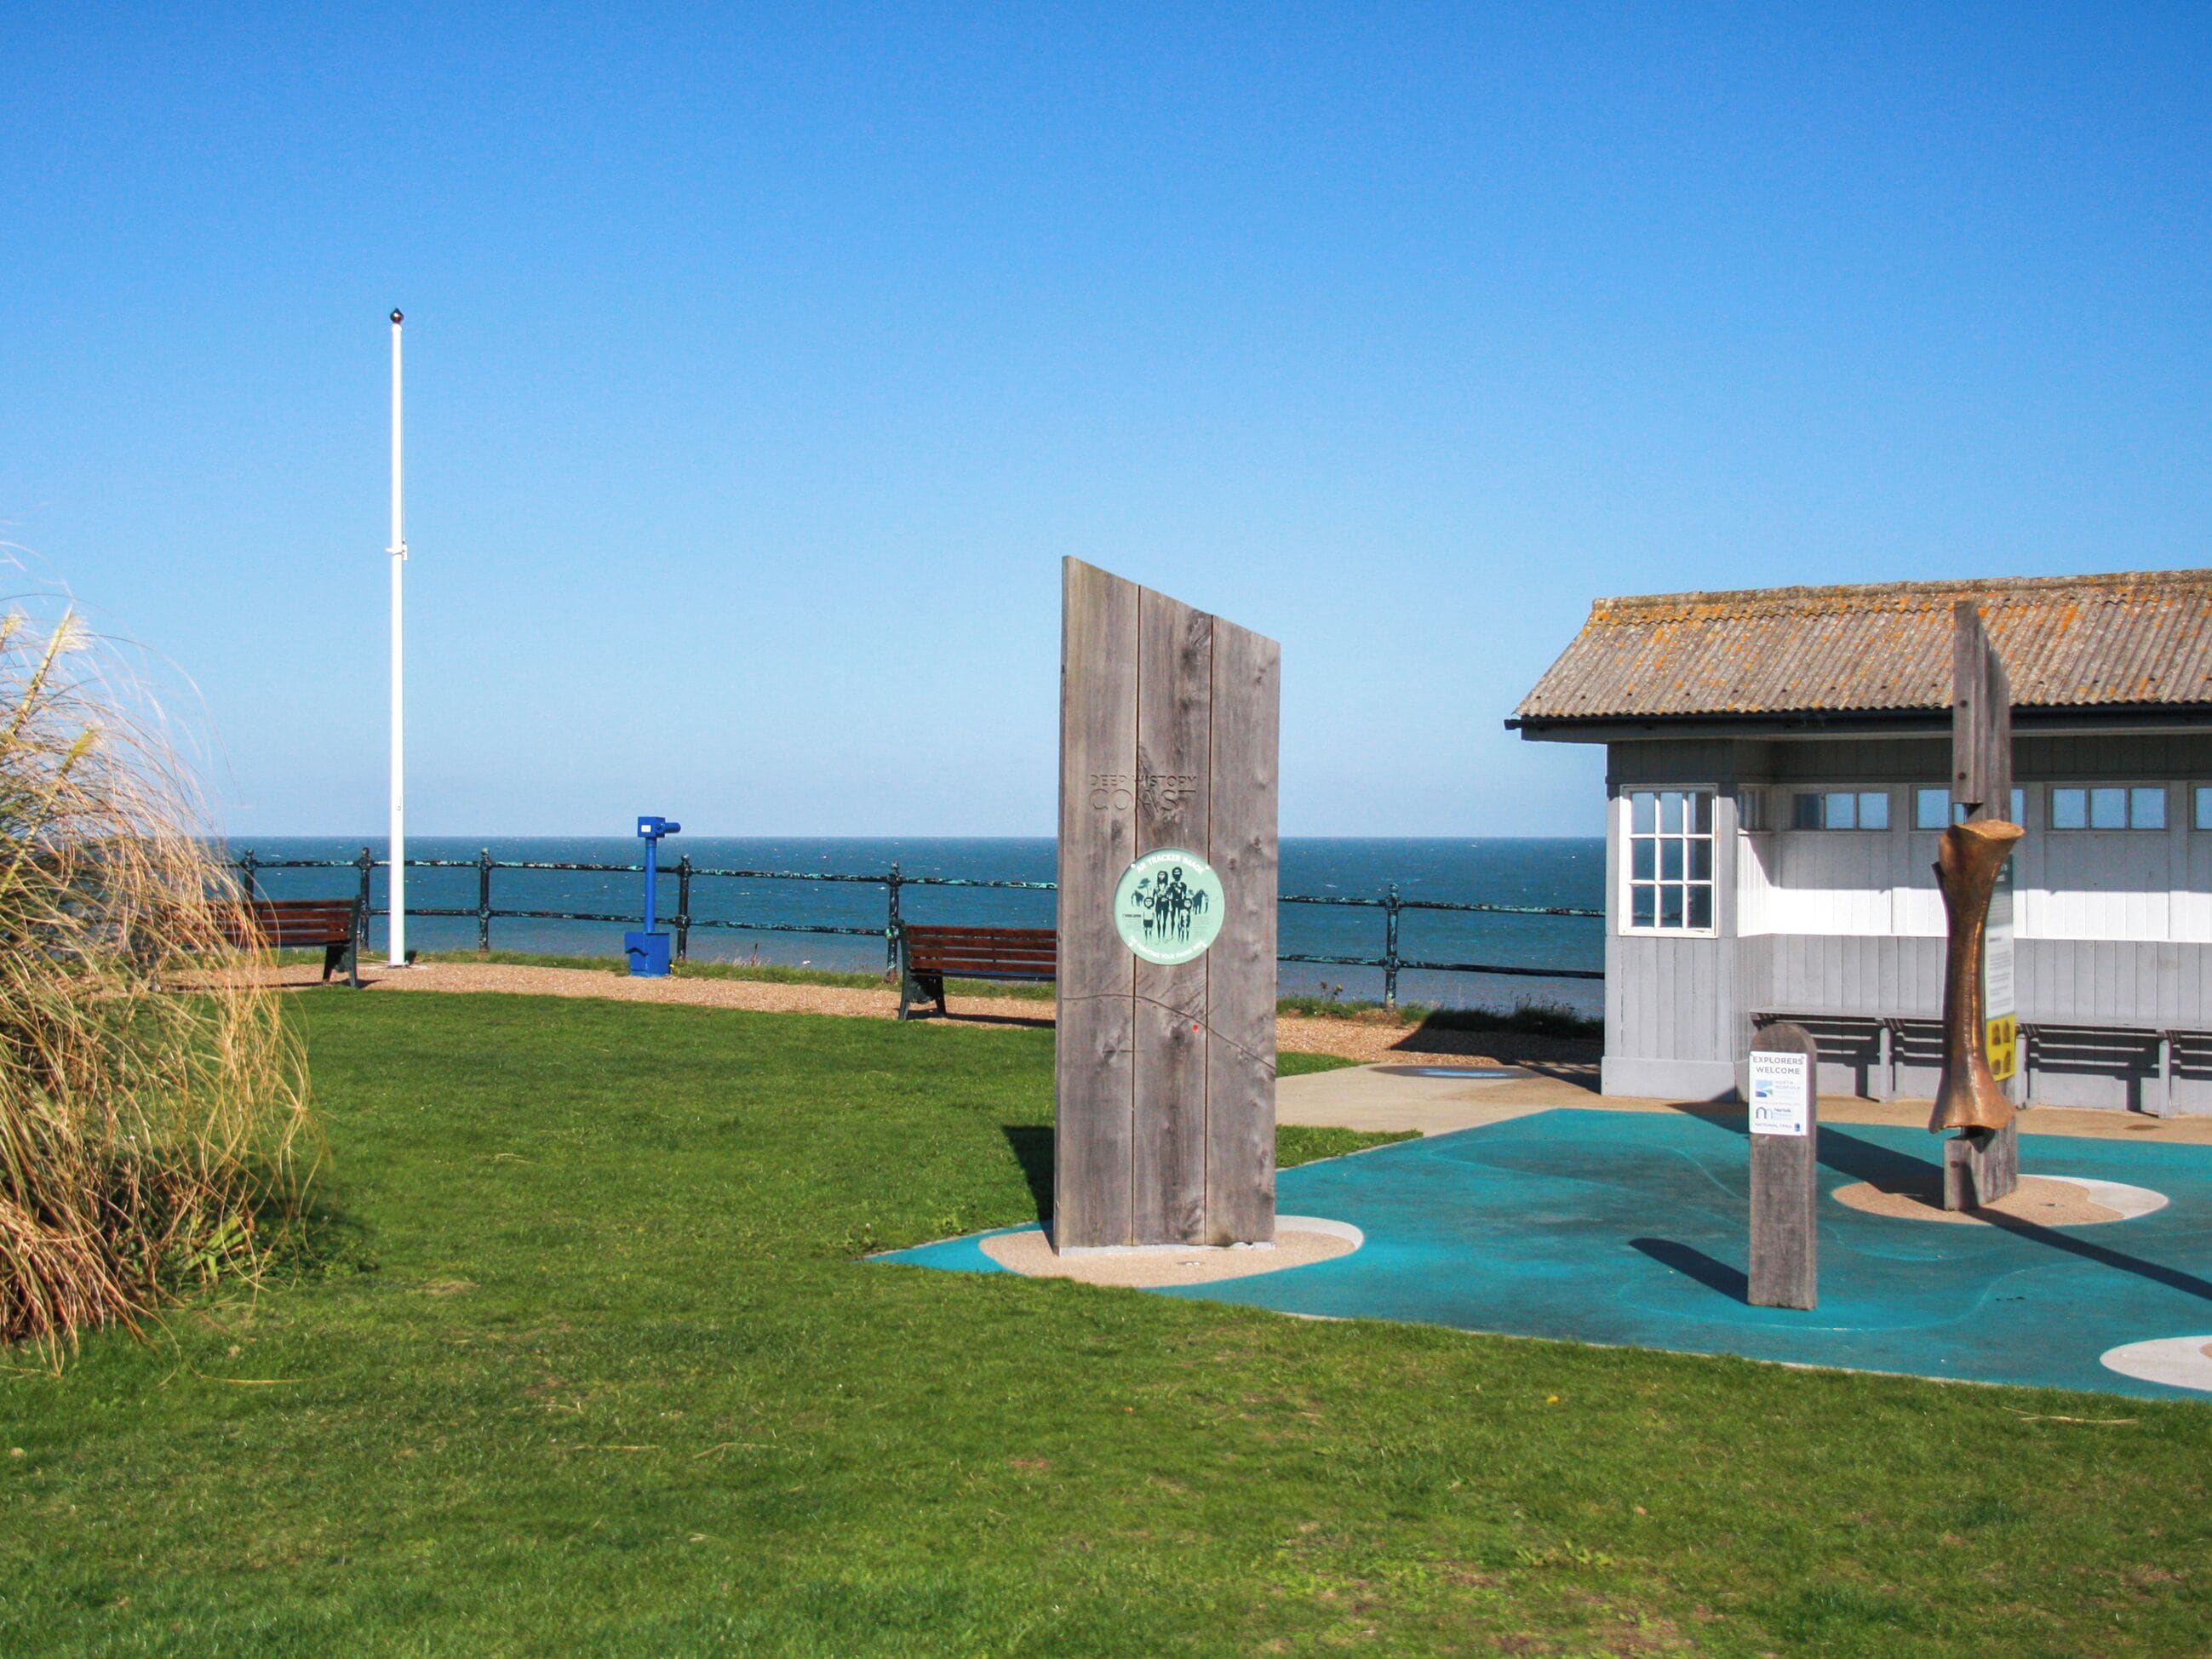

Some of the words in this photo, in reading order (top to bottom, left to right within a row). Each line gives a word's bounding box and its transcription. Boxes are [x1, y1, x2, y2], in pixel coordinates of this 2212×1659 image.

[1090, 775, 1127, 787] DEEP
[1132, 775, 1197, 787] HISTORY
[1089, 788, 1197, 811] COAST
[1148, 854, 1182, 866] TRACKER
[1756, 1066, 1800, 1074] WELCOME
